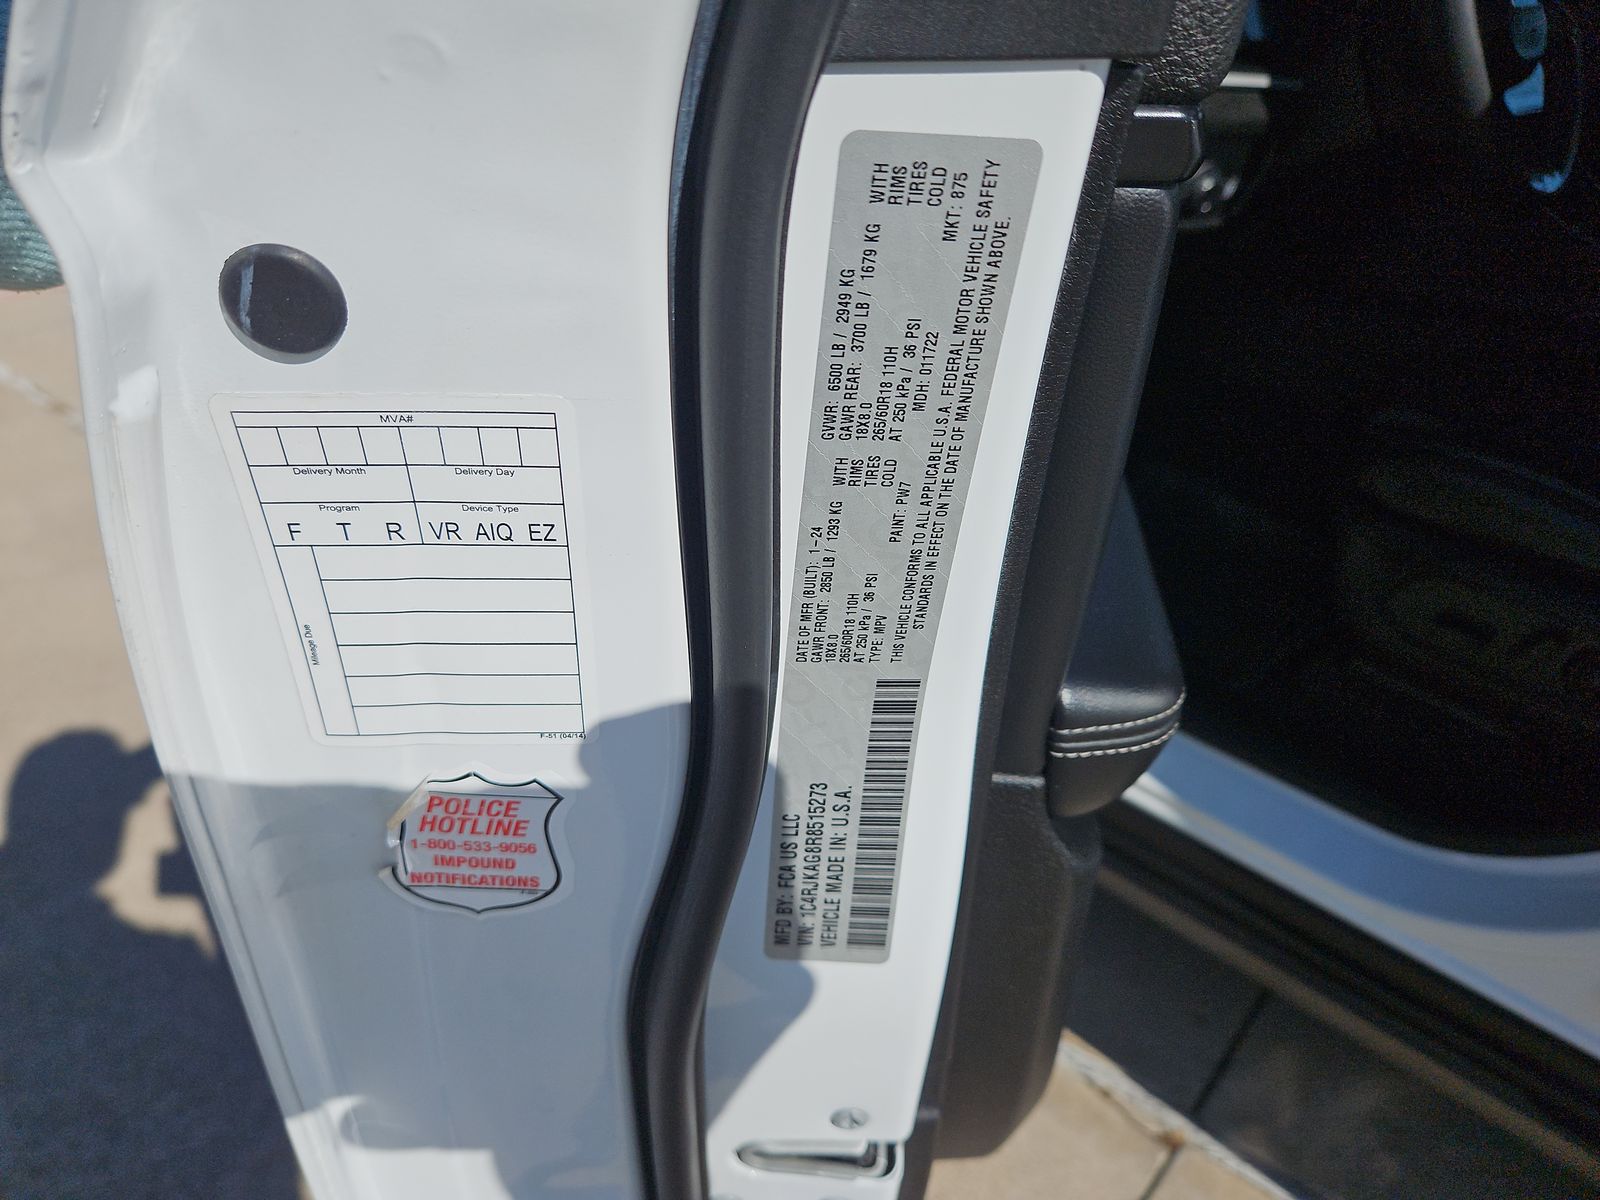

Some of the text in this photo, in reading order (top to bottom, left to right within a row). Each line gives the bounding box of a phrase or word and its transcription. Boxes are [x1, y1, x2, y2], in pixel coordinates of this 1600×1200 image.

[868, 163, 889, 203] WITH
[926, 167, 947, 207] COLD
[941, 172, 968, 242] MKT: 875
[863, 223, 881, 242] KG
[859, 249, 877, 280] 1679
[838, 269, 856, 287] KG
[835, 293, 852, 324] 2949
[853, 302, 870, 317] LB
[855, 166, 907, 441] 18X8.0 RIMS
[871, 161, 928, 441] 265/60R18 110H TIRES
[850, 323, 867, 352] 3700
[904, 318, 922, 339] PSI
[830, 343, 846, 358] LB
[902, 344, 917, 359] 36
[827, 363, 843, 391] 6500
[843, 362, 862, 400] REAR:
[911, 331, 939, 412] MDH: 011722
[894, 377, 912, 398] kPa
[379, 415, 414, 424] MVA#
[820, 400, 839, 440] GVWR:
[889, 159, 1000, 663] THIS VEHICLE CONFORMS TO ALL APPLICABLE U.S.A. FEDERAL MOTOR VEHICLE SAFETY
[891, 402, 907, 422] 250
[838, 405, 856, 441] GAWR
[912, 217, 1011, 630] STANDARDS IN EFFECT ON THE DATE OF MANUFACTURE SHOWN ABOVE.
[887, 427, 903, 442] AT
[293, 467, 367, 477] Delivery Month
[455, 467, 515, 478] Delivery Day
[832, 457, 849, 486] WITH
[880, 459, 897, 487] COLD
[318, 504, 361, 513] Program
[461, 504, 519, 514] Device Type
[828, 501, 843, 515] KG
[888, 481, 911, 542] PAINT: PW7
[287, 523, 405, 541] F T R
[428, 522, 557, 543] VR AIQ EZ
[825, 518, 840, 542] 1293
[821, 556, 835, 568] LB
[824, 459, 864, 663] 18X8.0 RIMS
[838, 455, 881, 663] 265/60R18 110H TIRES
[802, 561, 821, 599] (BUILT):
[819, 571, 833, 593] 2850
[864, 573, 878, 588] PSI
[862, 591, 875, 602] 36
[799, 602, 814, 622] MFR
[813, 599, 830, 633] FRONT:
[857, 615, 871, 631] kPa
[797, 625, 811, 637] OF
[855, 633, 868, 649] 250
[868, 614, 887, 663] TYPE: MPV
[303, 623, 320, 666] Mileage Due
[795, 639, 810, 662] DATE
[810, 636, 825, 663] GAWR
[852, 651, 865, 663] AT
[559, 732, 586, 740] (04/14)
[426, 795, 521, 818] POLICE
[419, 815, 529, 837] HOTLINE
[410, 838, 537, 854] 1-800-533-9056
[433, 854, 516, 870] IMPOUND
[796, 782, 828, 946] VIN: 1C4RJKAG8R8515273
[820, 785, 852, 947] VEHICLE MADE IN: U.S.A.
[410, 872, 541, 888] NOTIFICATIONS
[773, 814, 801, 944] MFD BY: FCA US LLC
